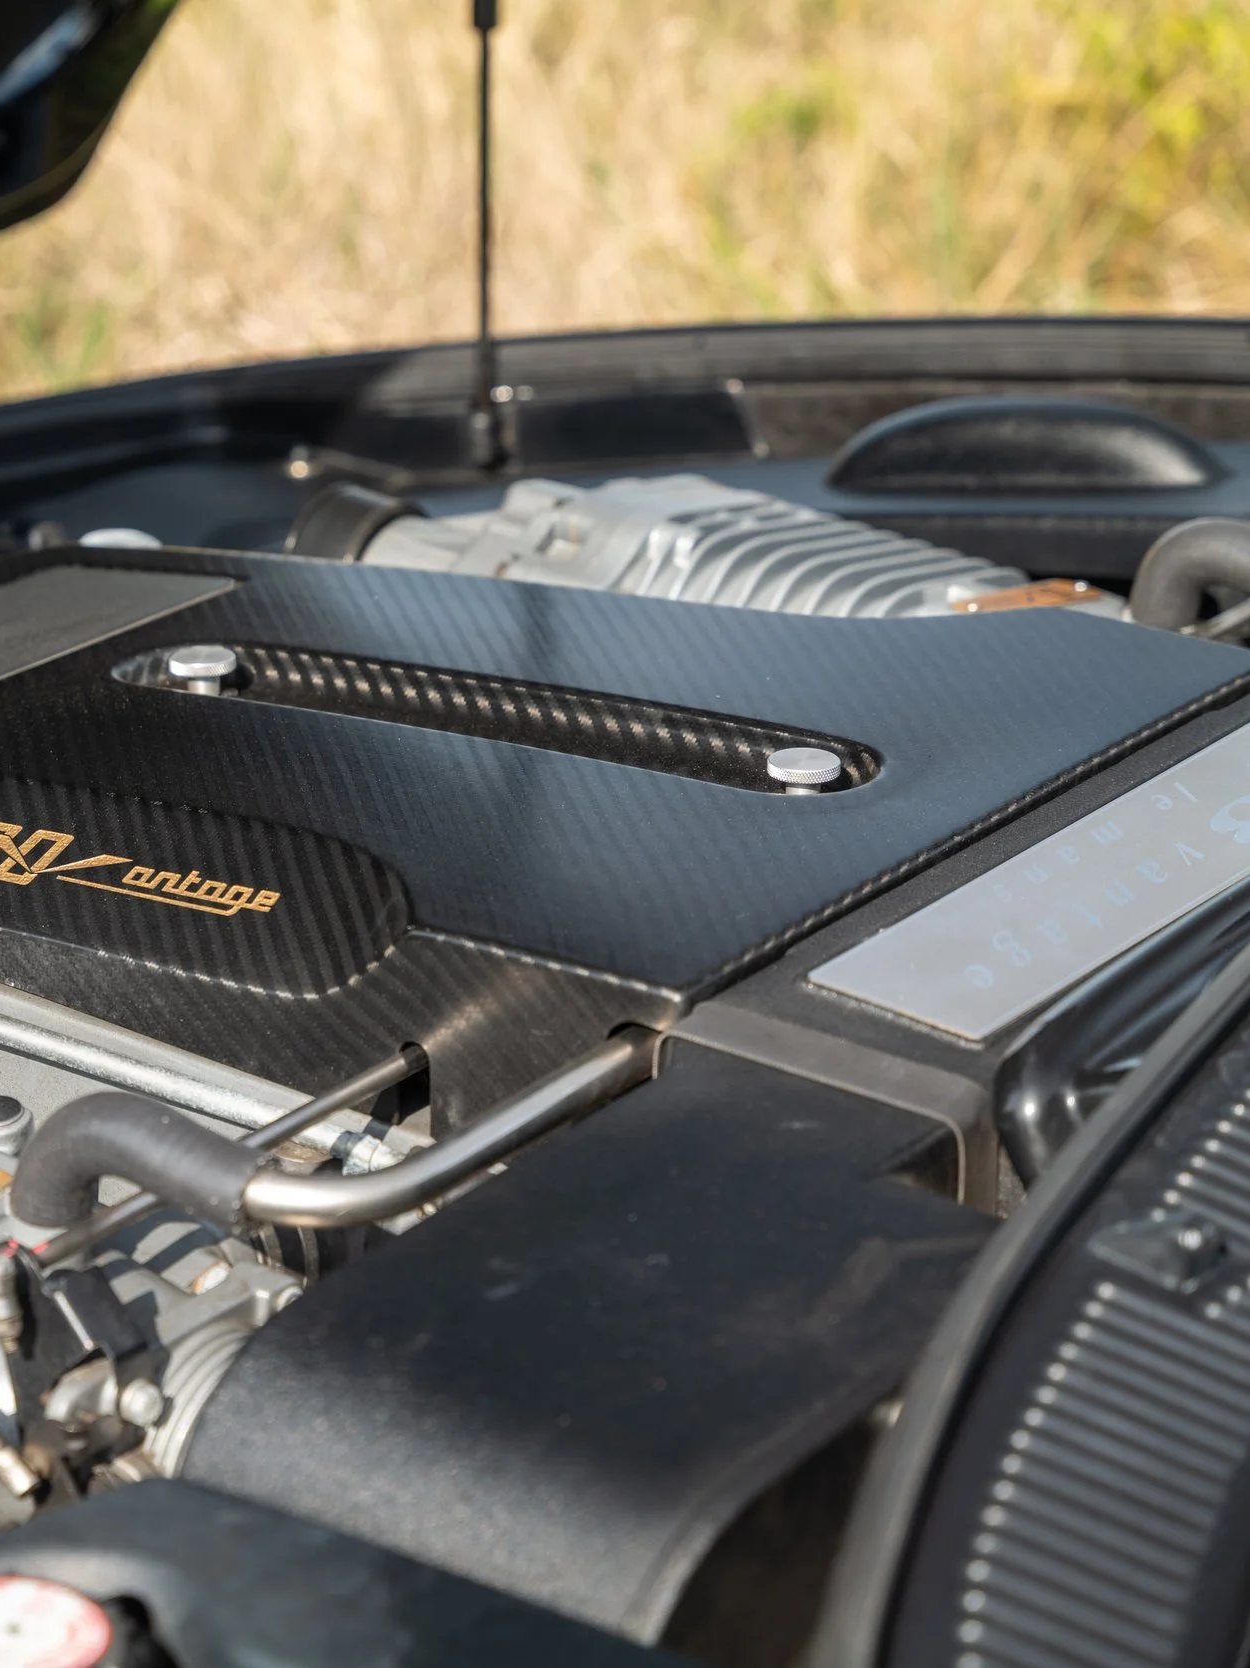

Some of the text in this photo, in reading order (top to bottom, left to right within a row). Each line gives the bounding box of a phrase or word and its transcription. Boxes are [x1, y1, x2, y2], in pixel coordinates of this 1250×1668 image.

[993, 782, 1198, 903] le mans
[963, 841, 1205, 989] vantage
